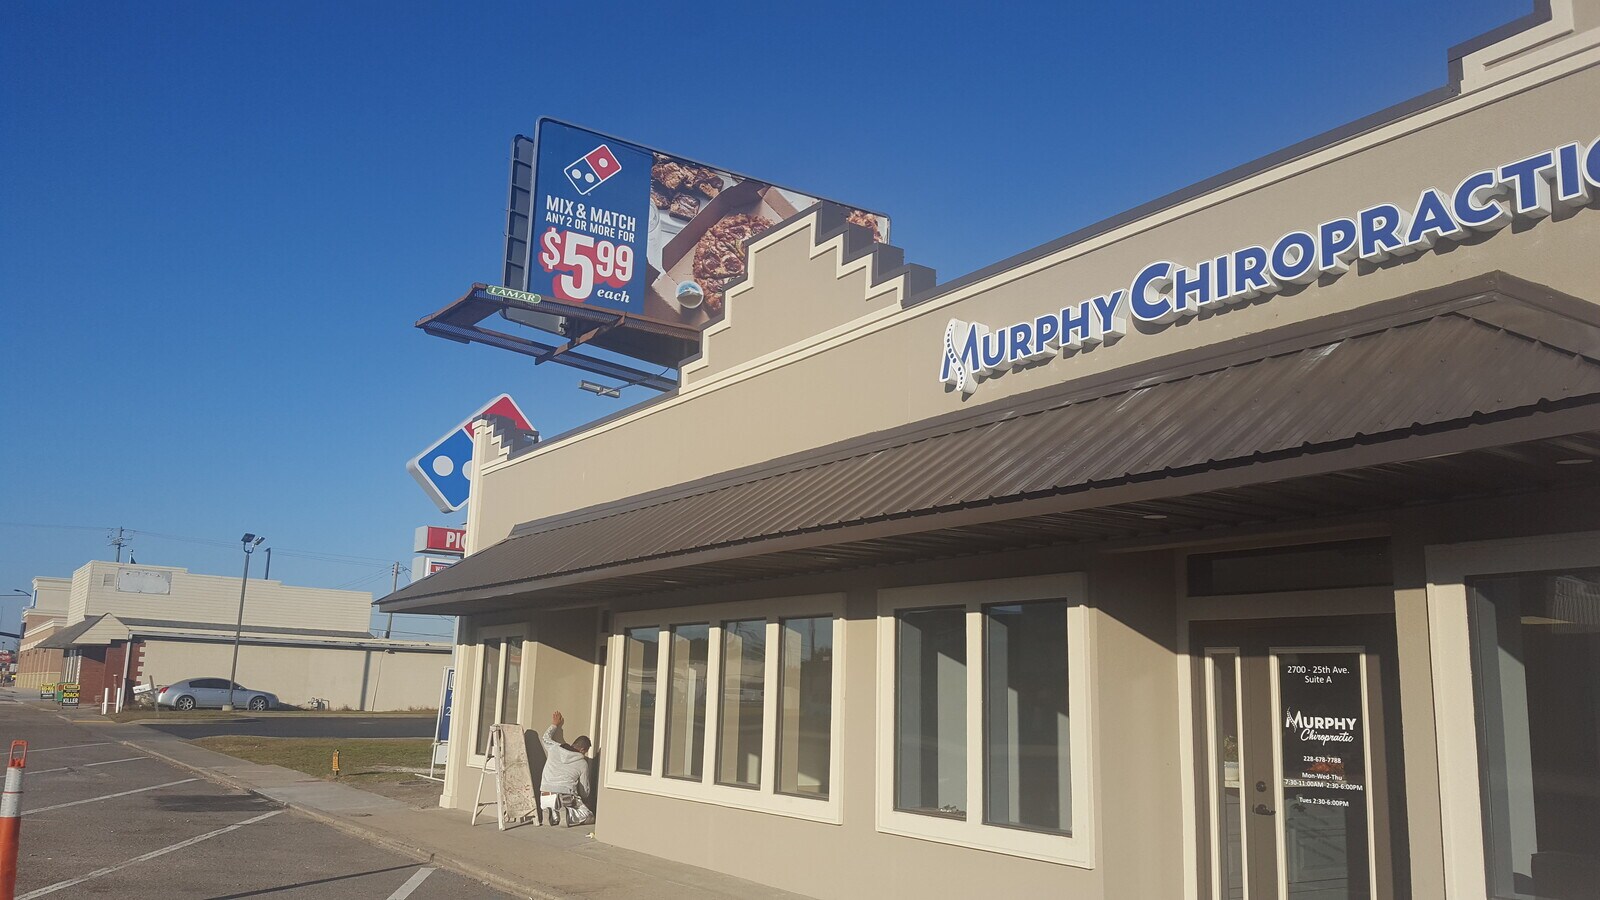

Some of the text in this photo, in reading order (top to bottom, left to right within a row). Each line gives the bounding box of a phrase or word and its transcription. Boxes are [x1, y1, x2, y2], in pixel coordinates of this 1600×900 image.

[546, 195, 636, 232] MIX & MATCH
[545, 211, 635, 243] ANY 2 OR MORE FOR
[491, 287, 536, 302] LAMAR
[597, 288, 630, 303] each
[939, 289, 1126, 391] MURPHY
[1287, 665, 1307, 674] 2700
[1312, 665, 1331, 674] 25th
[1332, 666, 1350, 674] Ave.
[1304, 675, 1333, 684] Suite A
[1285, 707, 1357, 732] MURPHY
[1300, 728, 1354, 746] Chiropractic
[1303, 755, 1342, 764] 228-678-7788
[1301, 772, 1343, 781] Mon-Wed-Thu
[1326, 782, 1363, 791] 2:30-6:00PM
[1299, 796, 1350, 807] Tues 2:30-6:00PM
